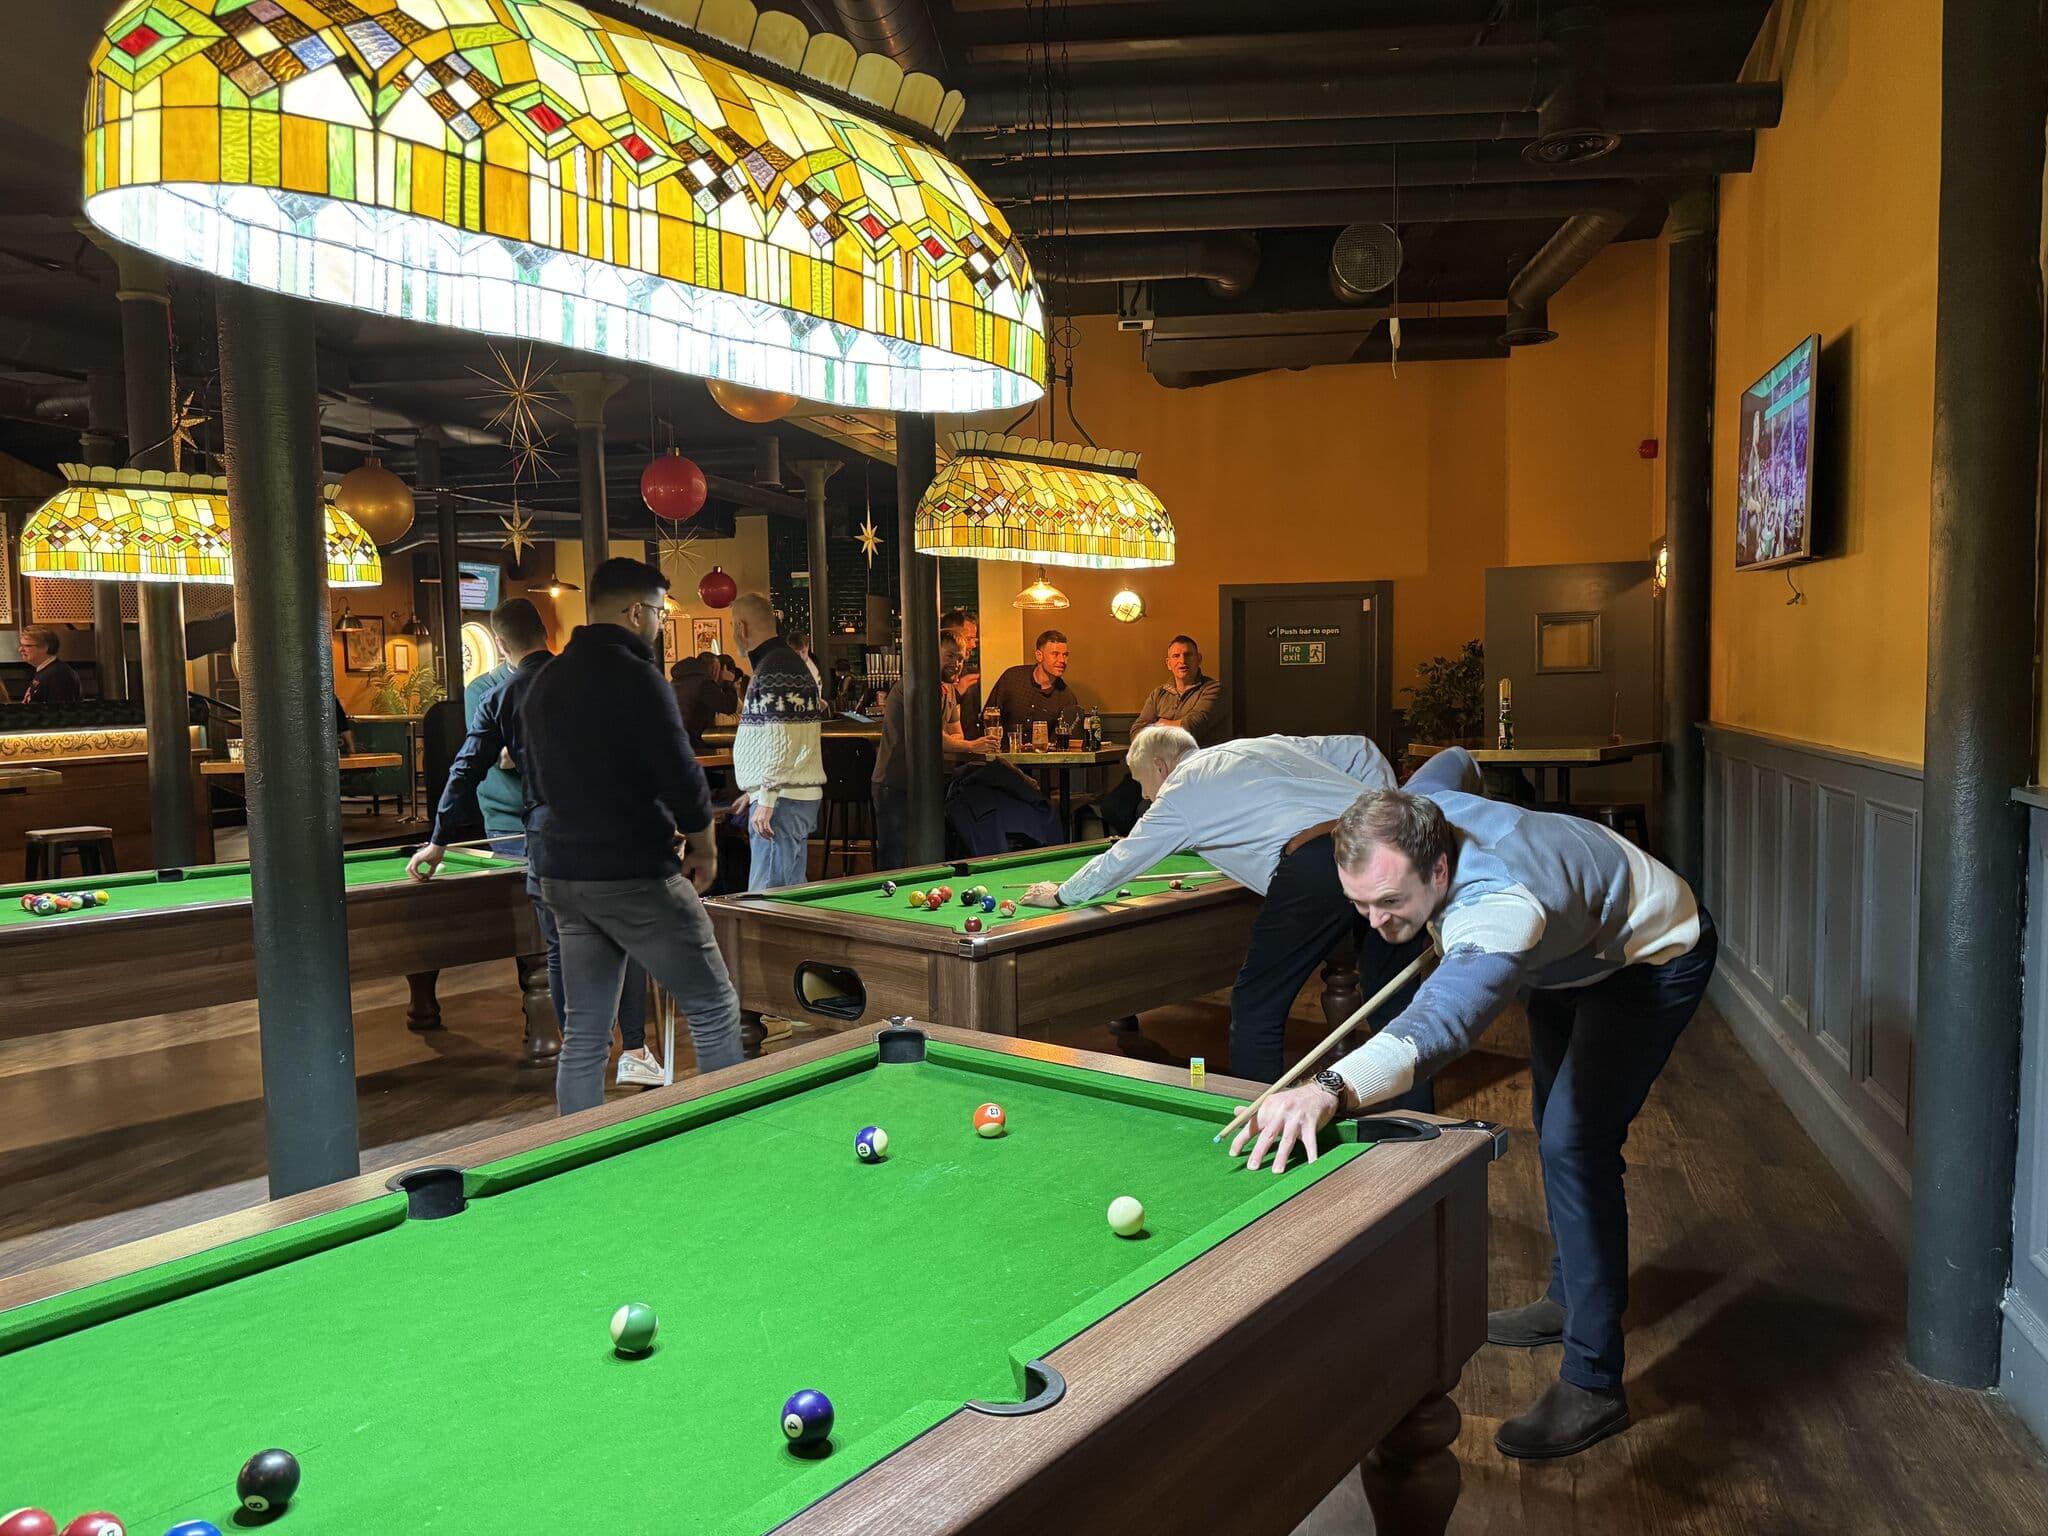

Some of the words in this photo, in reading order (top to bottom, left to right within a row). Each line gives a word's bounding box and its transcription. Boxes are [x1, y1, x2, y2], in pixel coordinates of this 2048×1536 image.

[1282, 644, 1301, 653] Fire
[1283, 652, 1301, 661] exit
[787, 1421, 798, 1430] 4
